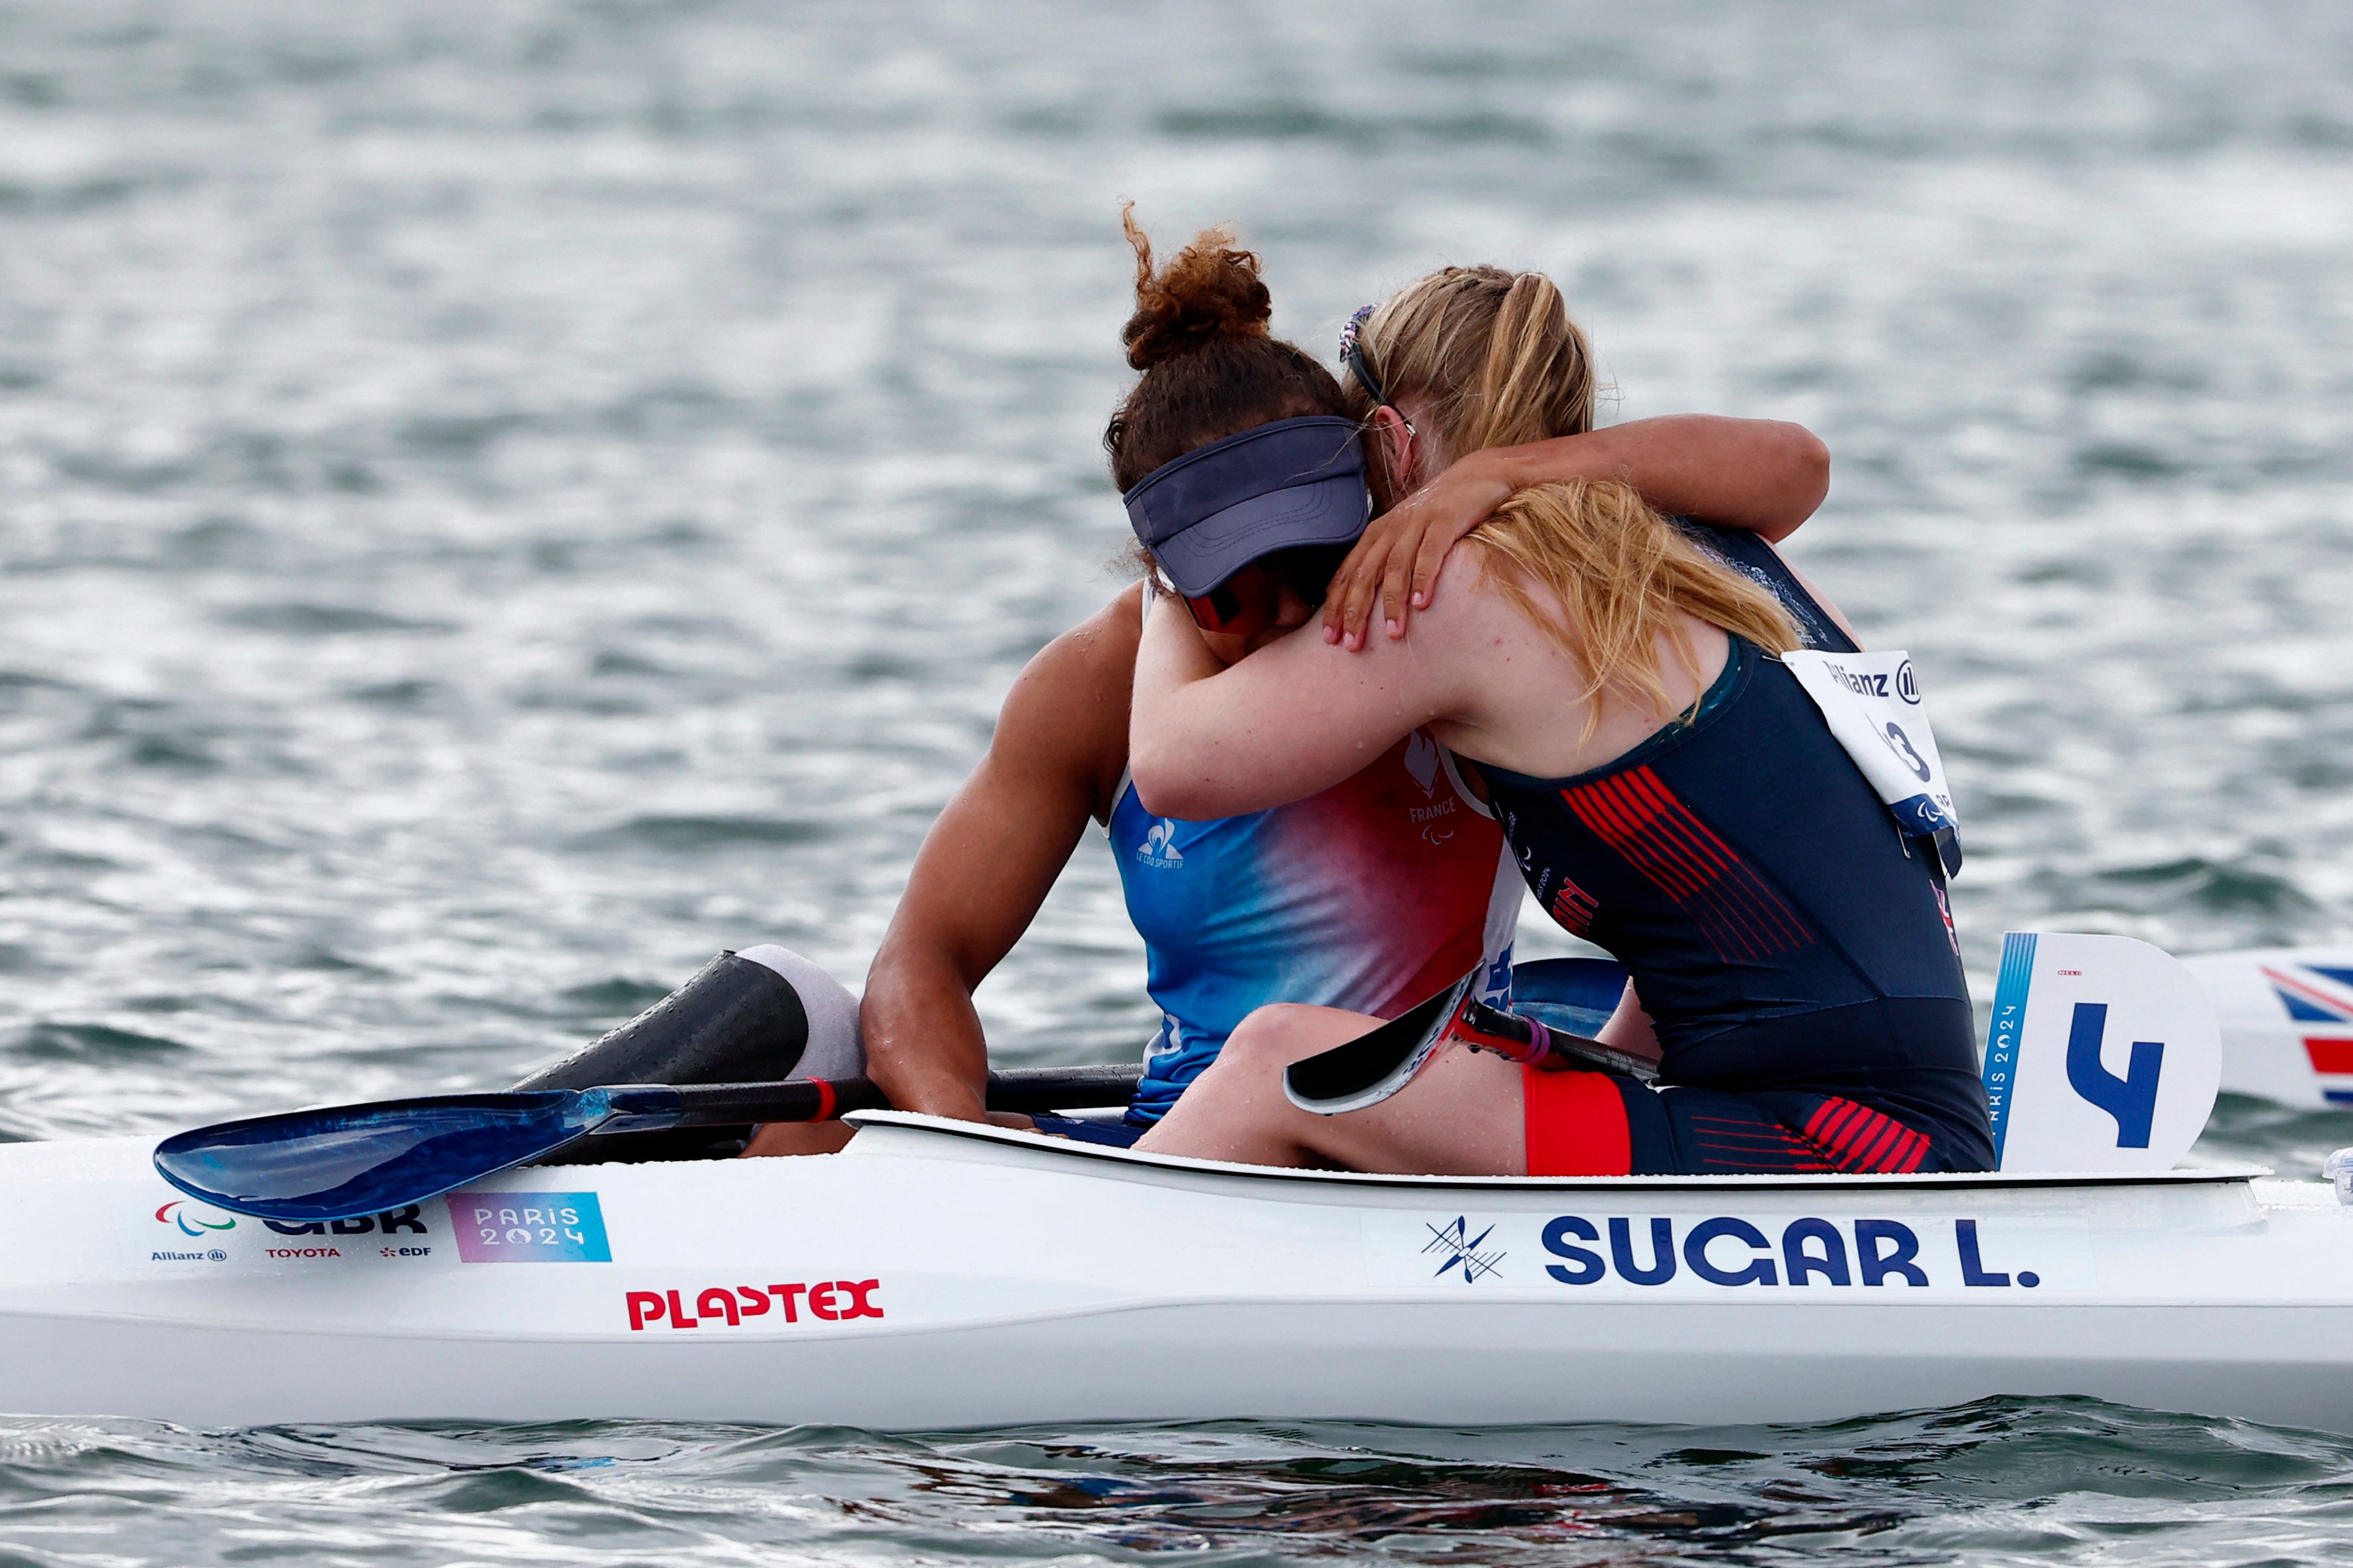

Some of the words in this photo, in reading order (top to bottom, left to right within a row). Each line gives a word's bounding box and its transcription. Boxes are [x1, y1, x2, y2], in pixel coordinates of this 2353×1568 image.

[1409, 796, 1456, 824] FRANCE
[1136, 851, 1142, 862] LE
[1143, 854, 1155, 866] COQ
[1155, 858, 1184, 869] SPORTIF
[1995, 1005, 2016, 1063] 2024
[2066, 1002, 2165, 1148] 4
[480, 1228, 584, 1245] 2024
[151, 1251, 205, 1261] Allianz
[265, 1248, 341, 1258] TOYOTA
[1541, 1215, 1929, 1286] SUGAR
[1954, 1218, 2040, 1288] L.
[625, 1279, 884, 1331] PLASTEX
